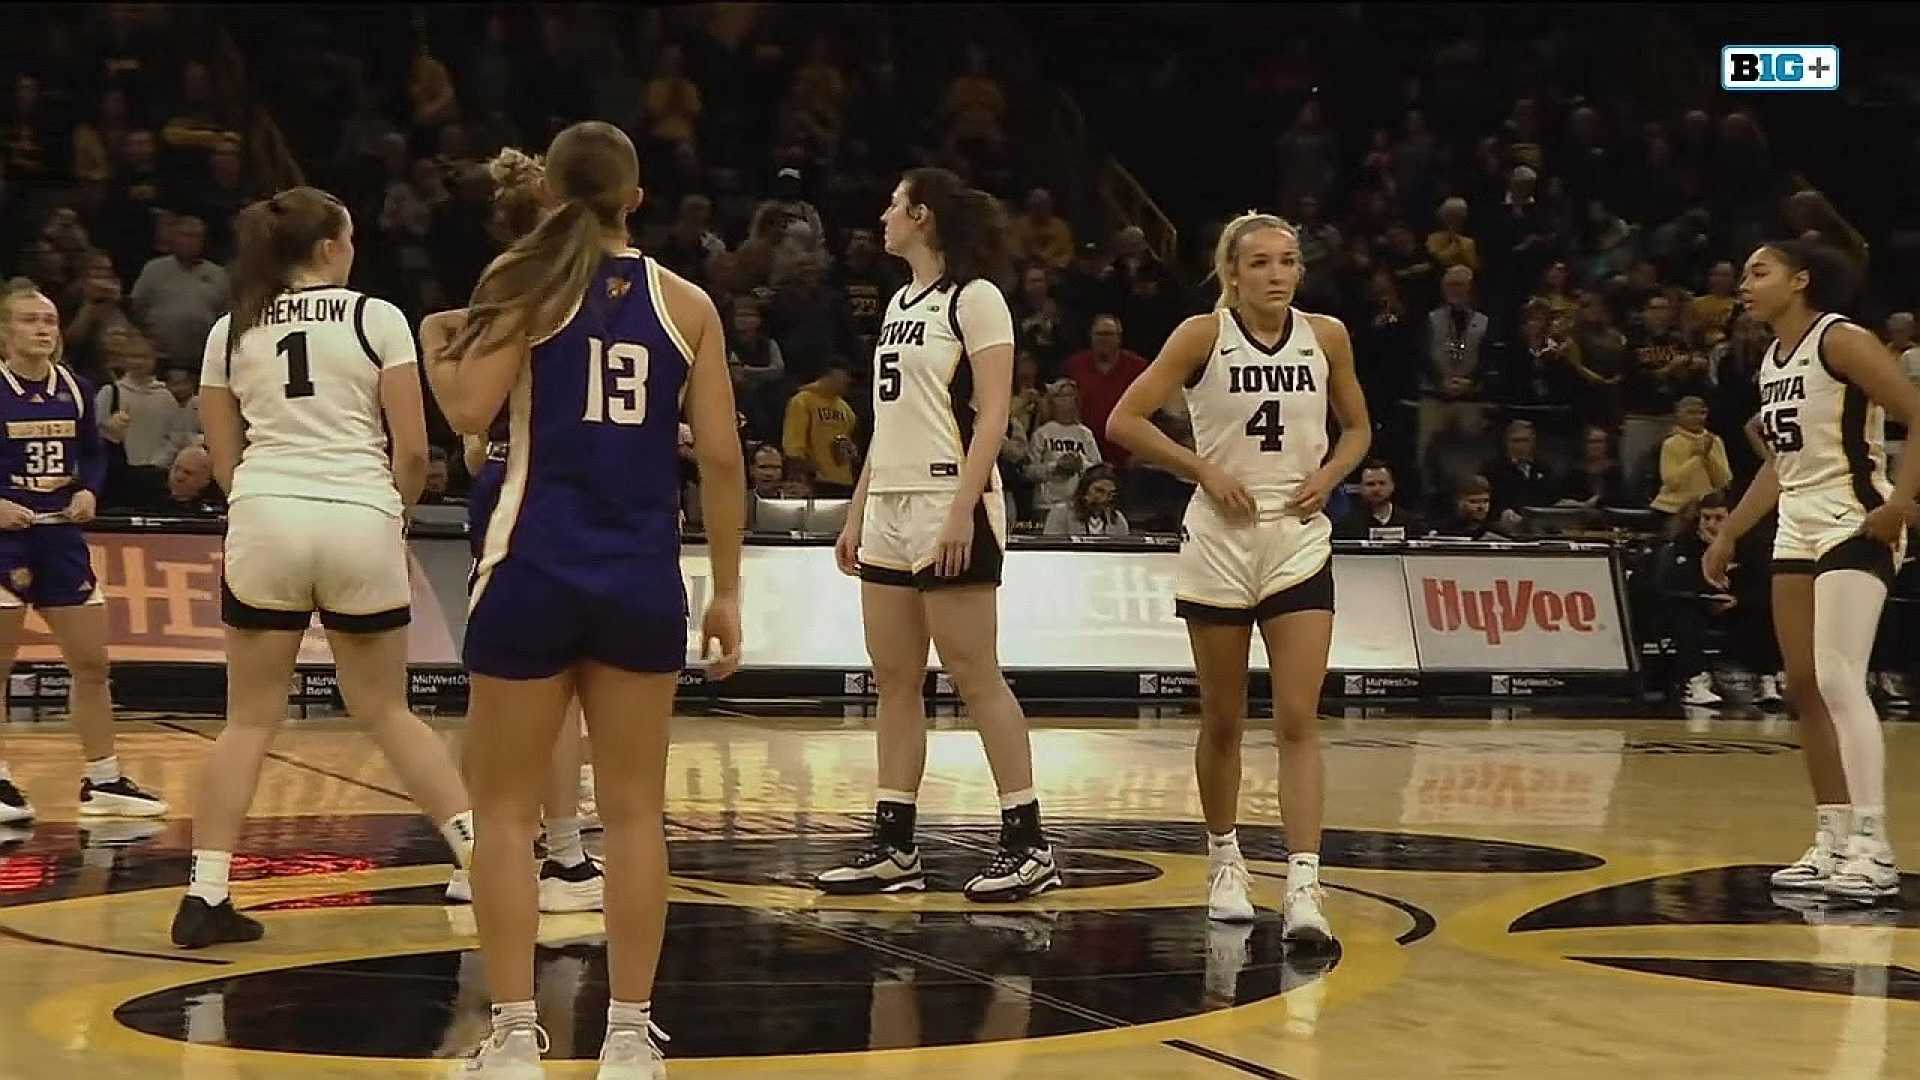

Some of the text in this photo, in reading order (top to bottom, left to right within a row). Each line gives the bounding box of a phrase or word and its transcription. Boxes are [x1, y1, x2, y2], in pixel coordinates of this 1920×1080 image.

[276, 331, 315, 398] 1
[581, 336, 649, 424] 13
[879, 353, 901, 401] 5
[1229, 365, 1316, 393] IOWA
[1246, 400, 1284, 451] 4
[25, 440, 64, 474] 32
